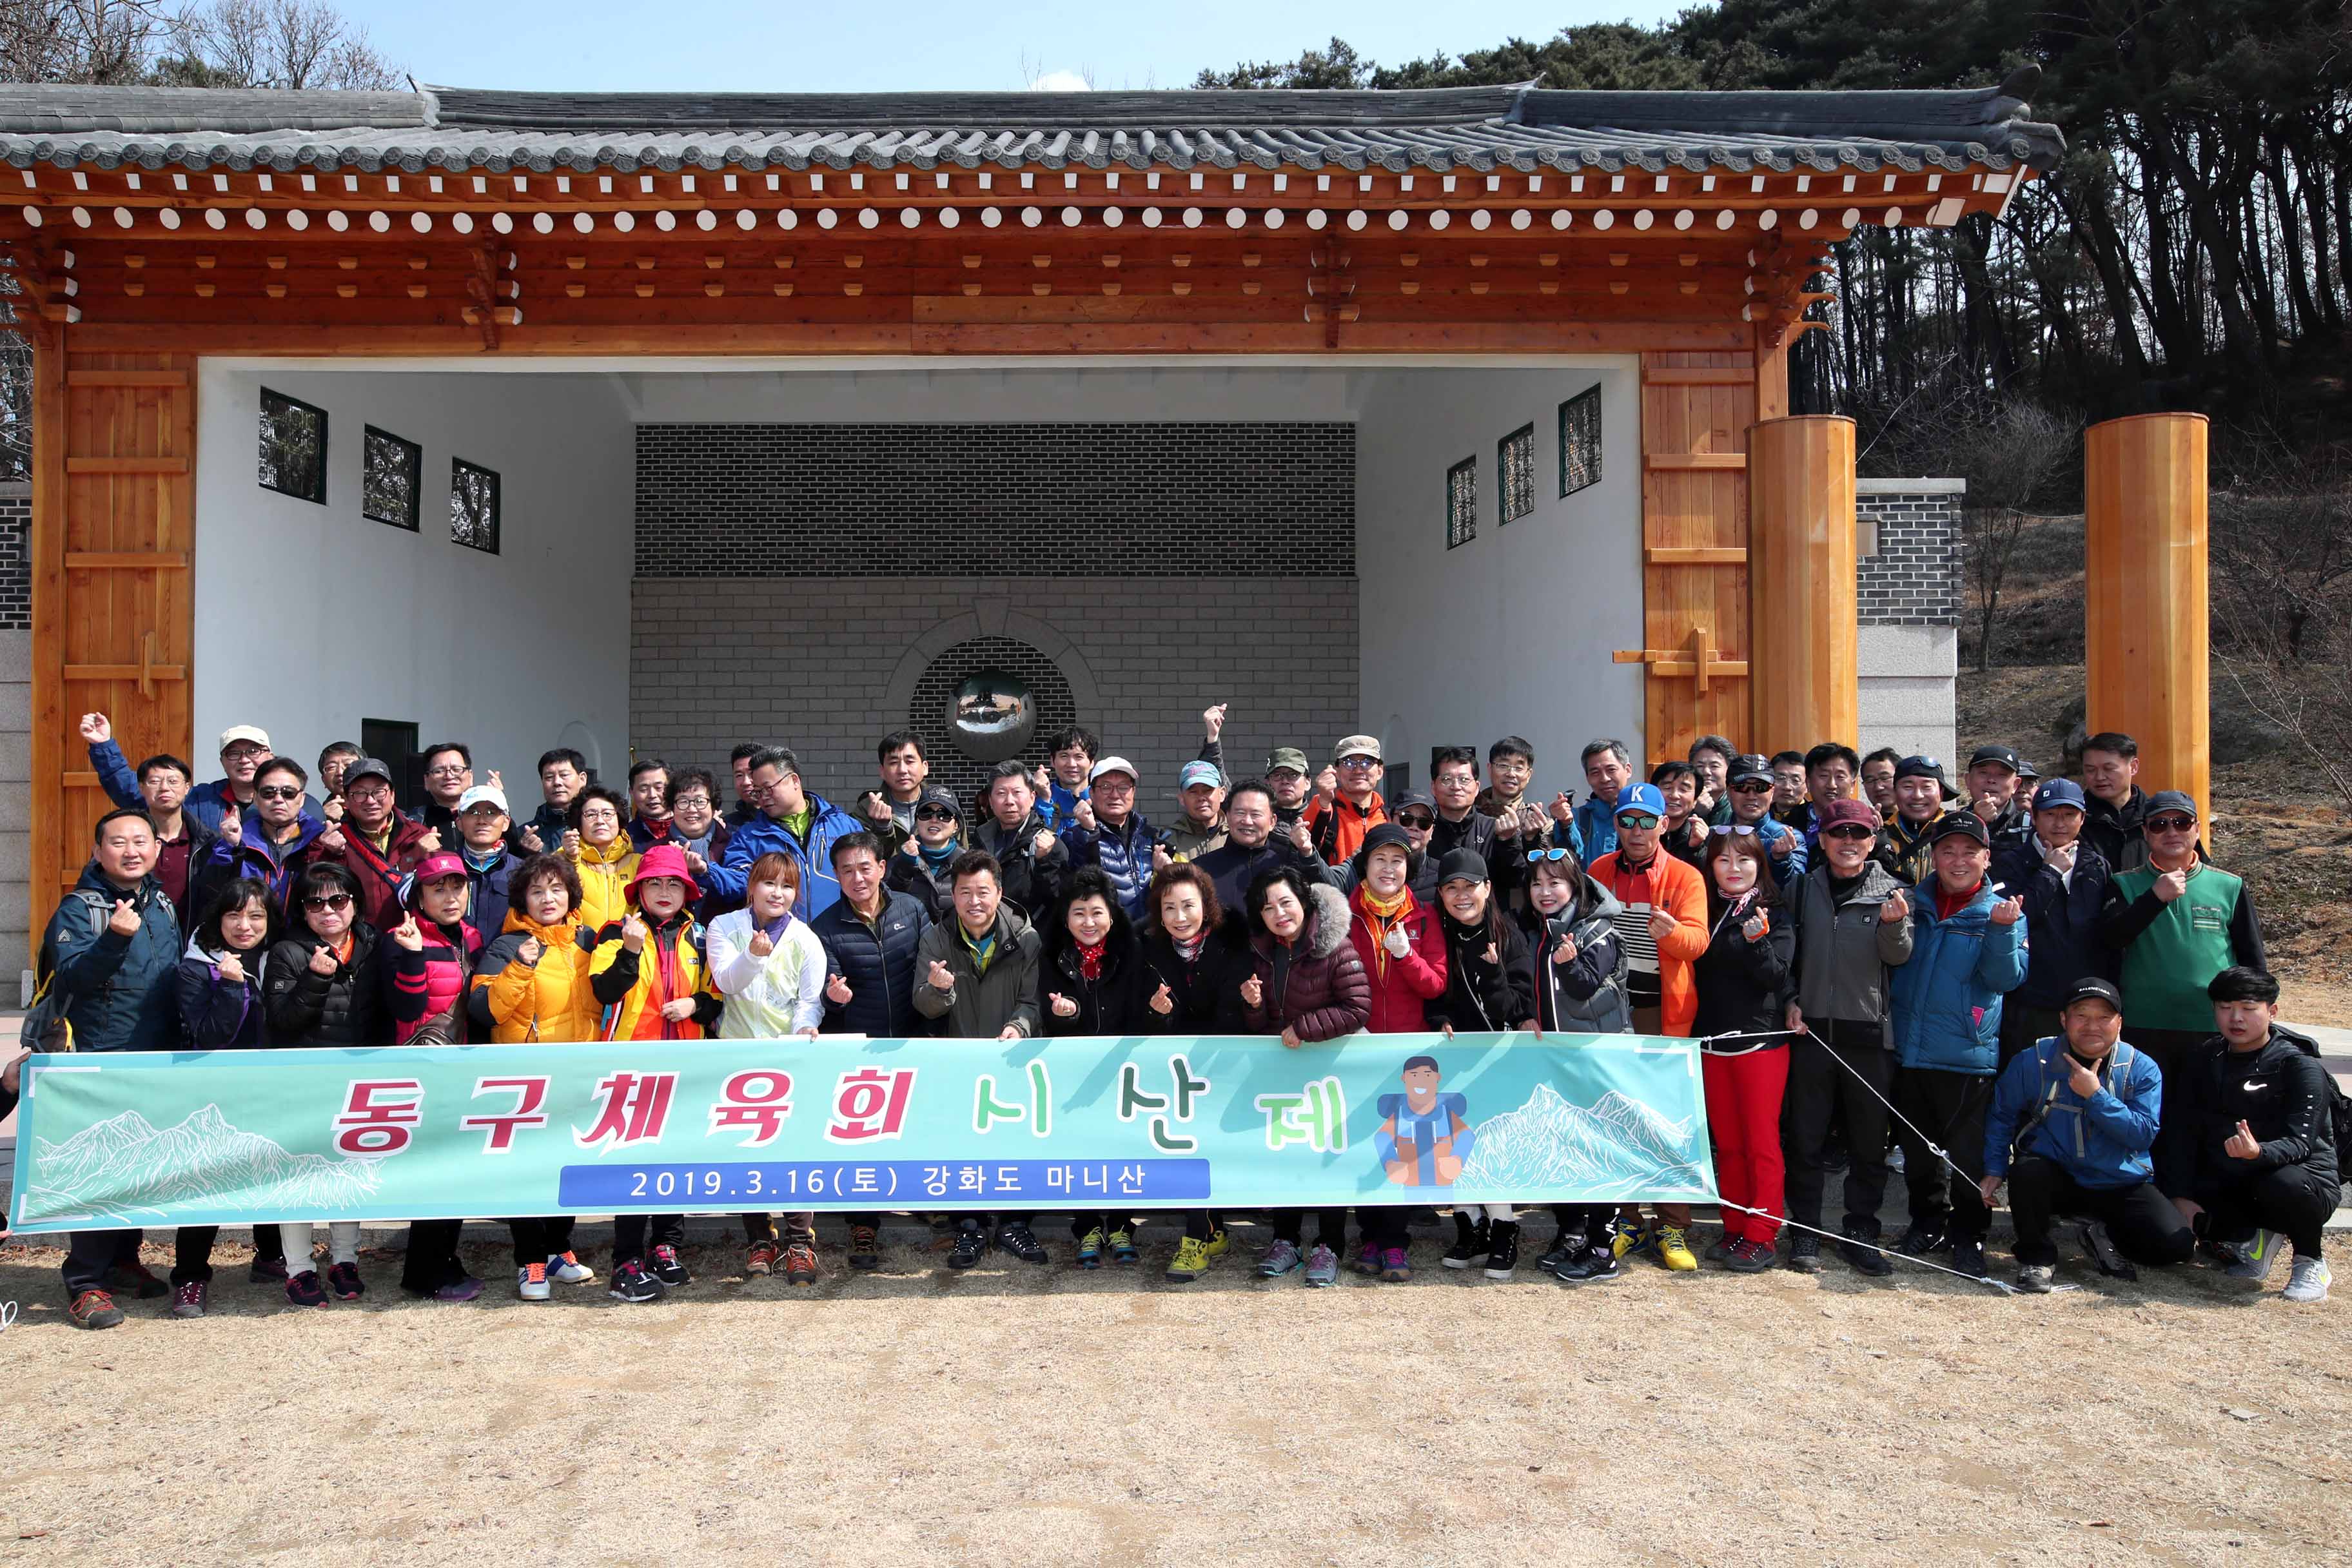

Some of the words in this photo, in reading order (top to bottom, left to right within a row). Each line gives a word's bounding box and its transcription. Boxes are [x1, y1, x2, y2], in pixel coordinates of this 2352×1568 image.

[1631, 786, 1643, 802] K
[333, 1066, 917, 1155] 동구체육회
[972, 1054, 1348, 1153] 시산제
[630, 1166, 897, 1197] 2019.3.16(토)
[923, 1165, 1022, 1196] 강화도
[1047, 1164, 1146, 1193] 마니산
